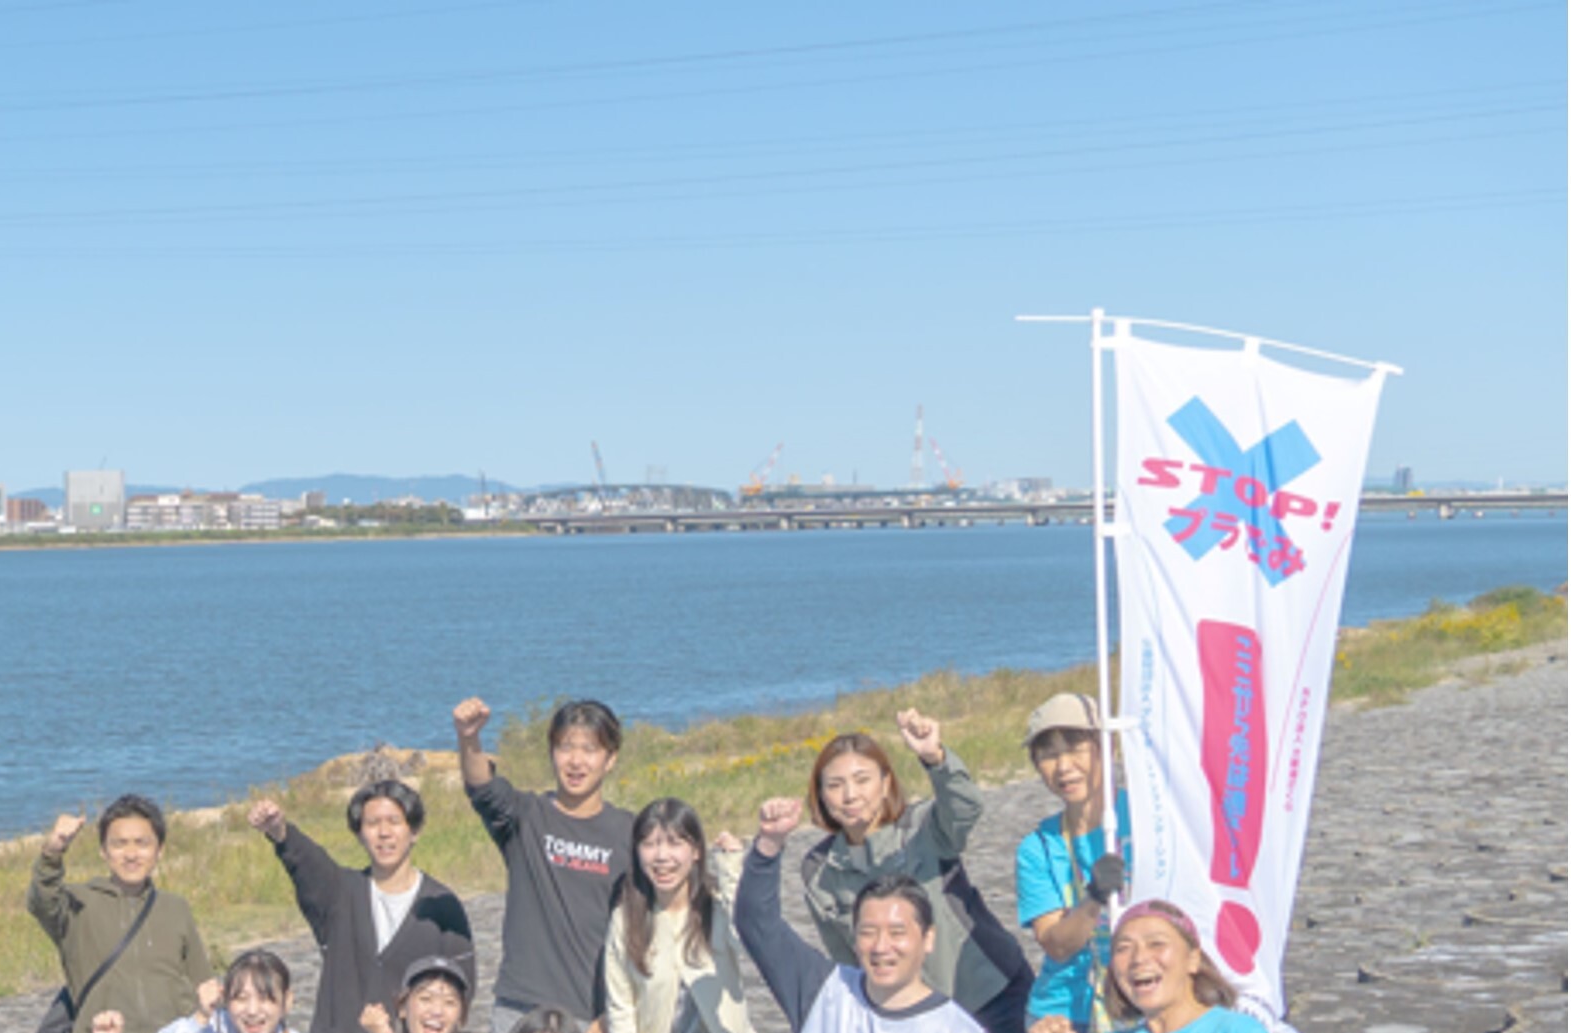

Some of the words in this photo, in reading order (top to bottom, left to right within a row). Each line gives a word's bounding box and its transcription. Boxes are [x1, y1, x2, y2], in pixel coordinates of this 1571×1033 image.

[1137, 457, 1342, 533] STOP!
[1168, 505, 1307, 578] プラごみ
[544, 834, 613, 864] TOMMY
